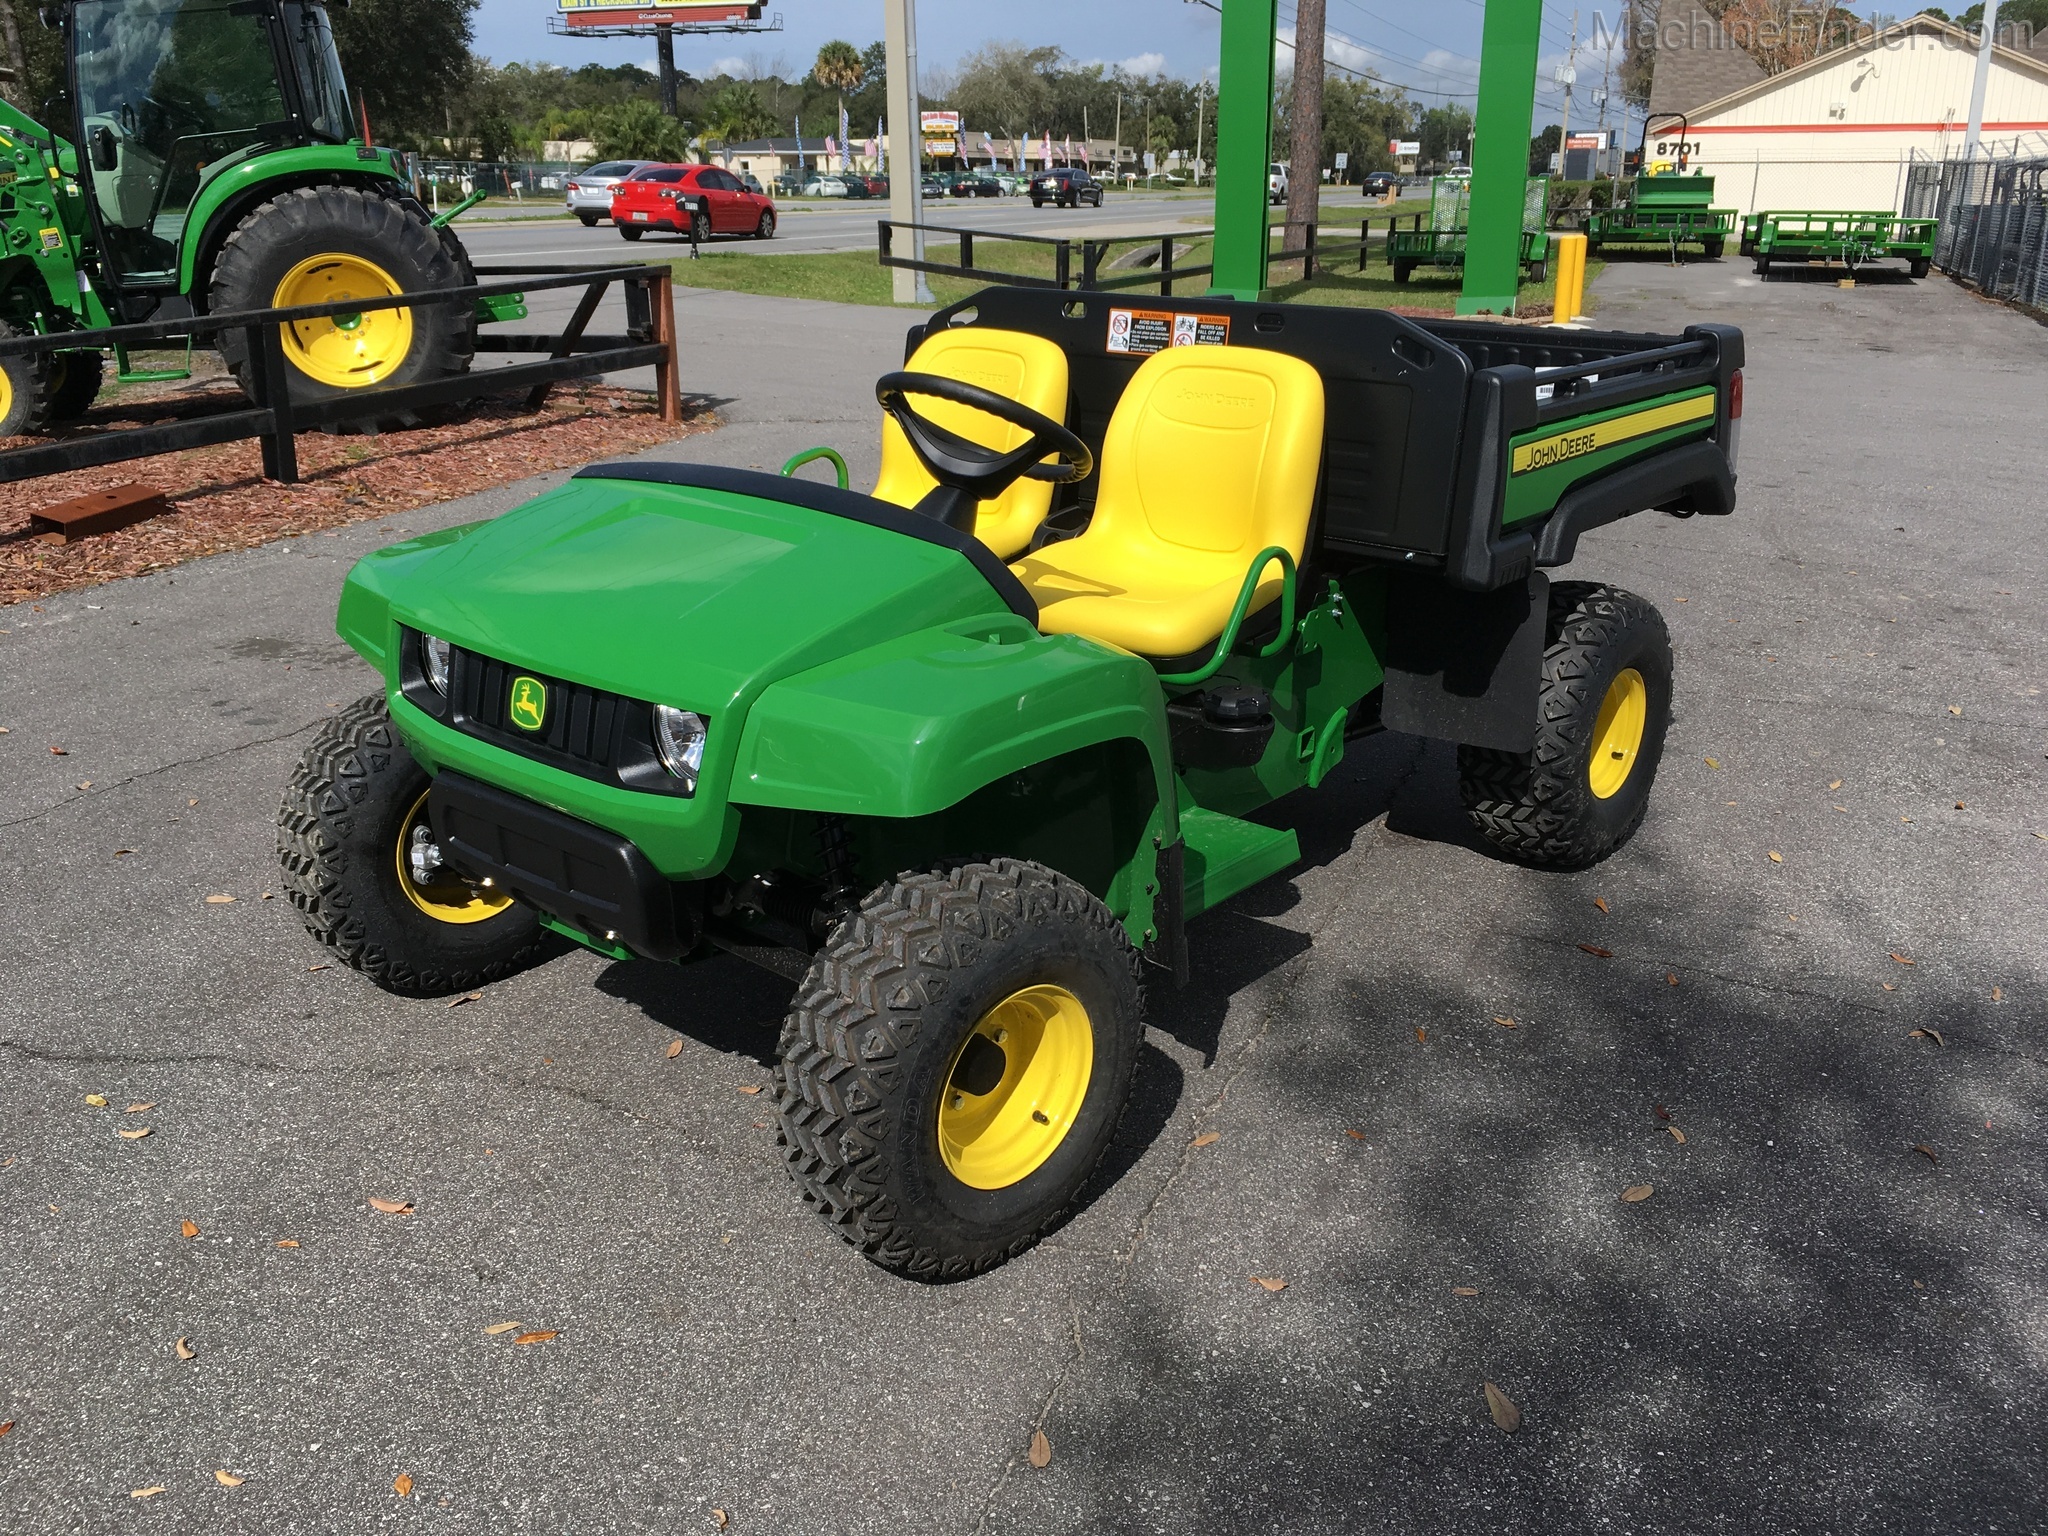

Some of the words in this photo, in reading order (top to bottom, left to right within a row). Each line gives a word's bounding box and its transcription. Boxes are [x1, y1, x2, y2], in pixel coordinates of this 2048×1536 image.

[1656, 142, 1700, 156] 8701
[979, 370, 1010, 384] DEERE
[1176, 387, 1213, 405] JOHN
[1216, 392, 1256, 408] DEERE
[1526, 443, 1558, 469] JOHN
[1560, 433, 1596, 458] DEERE
